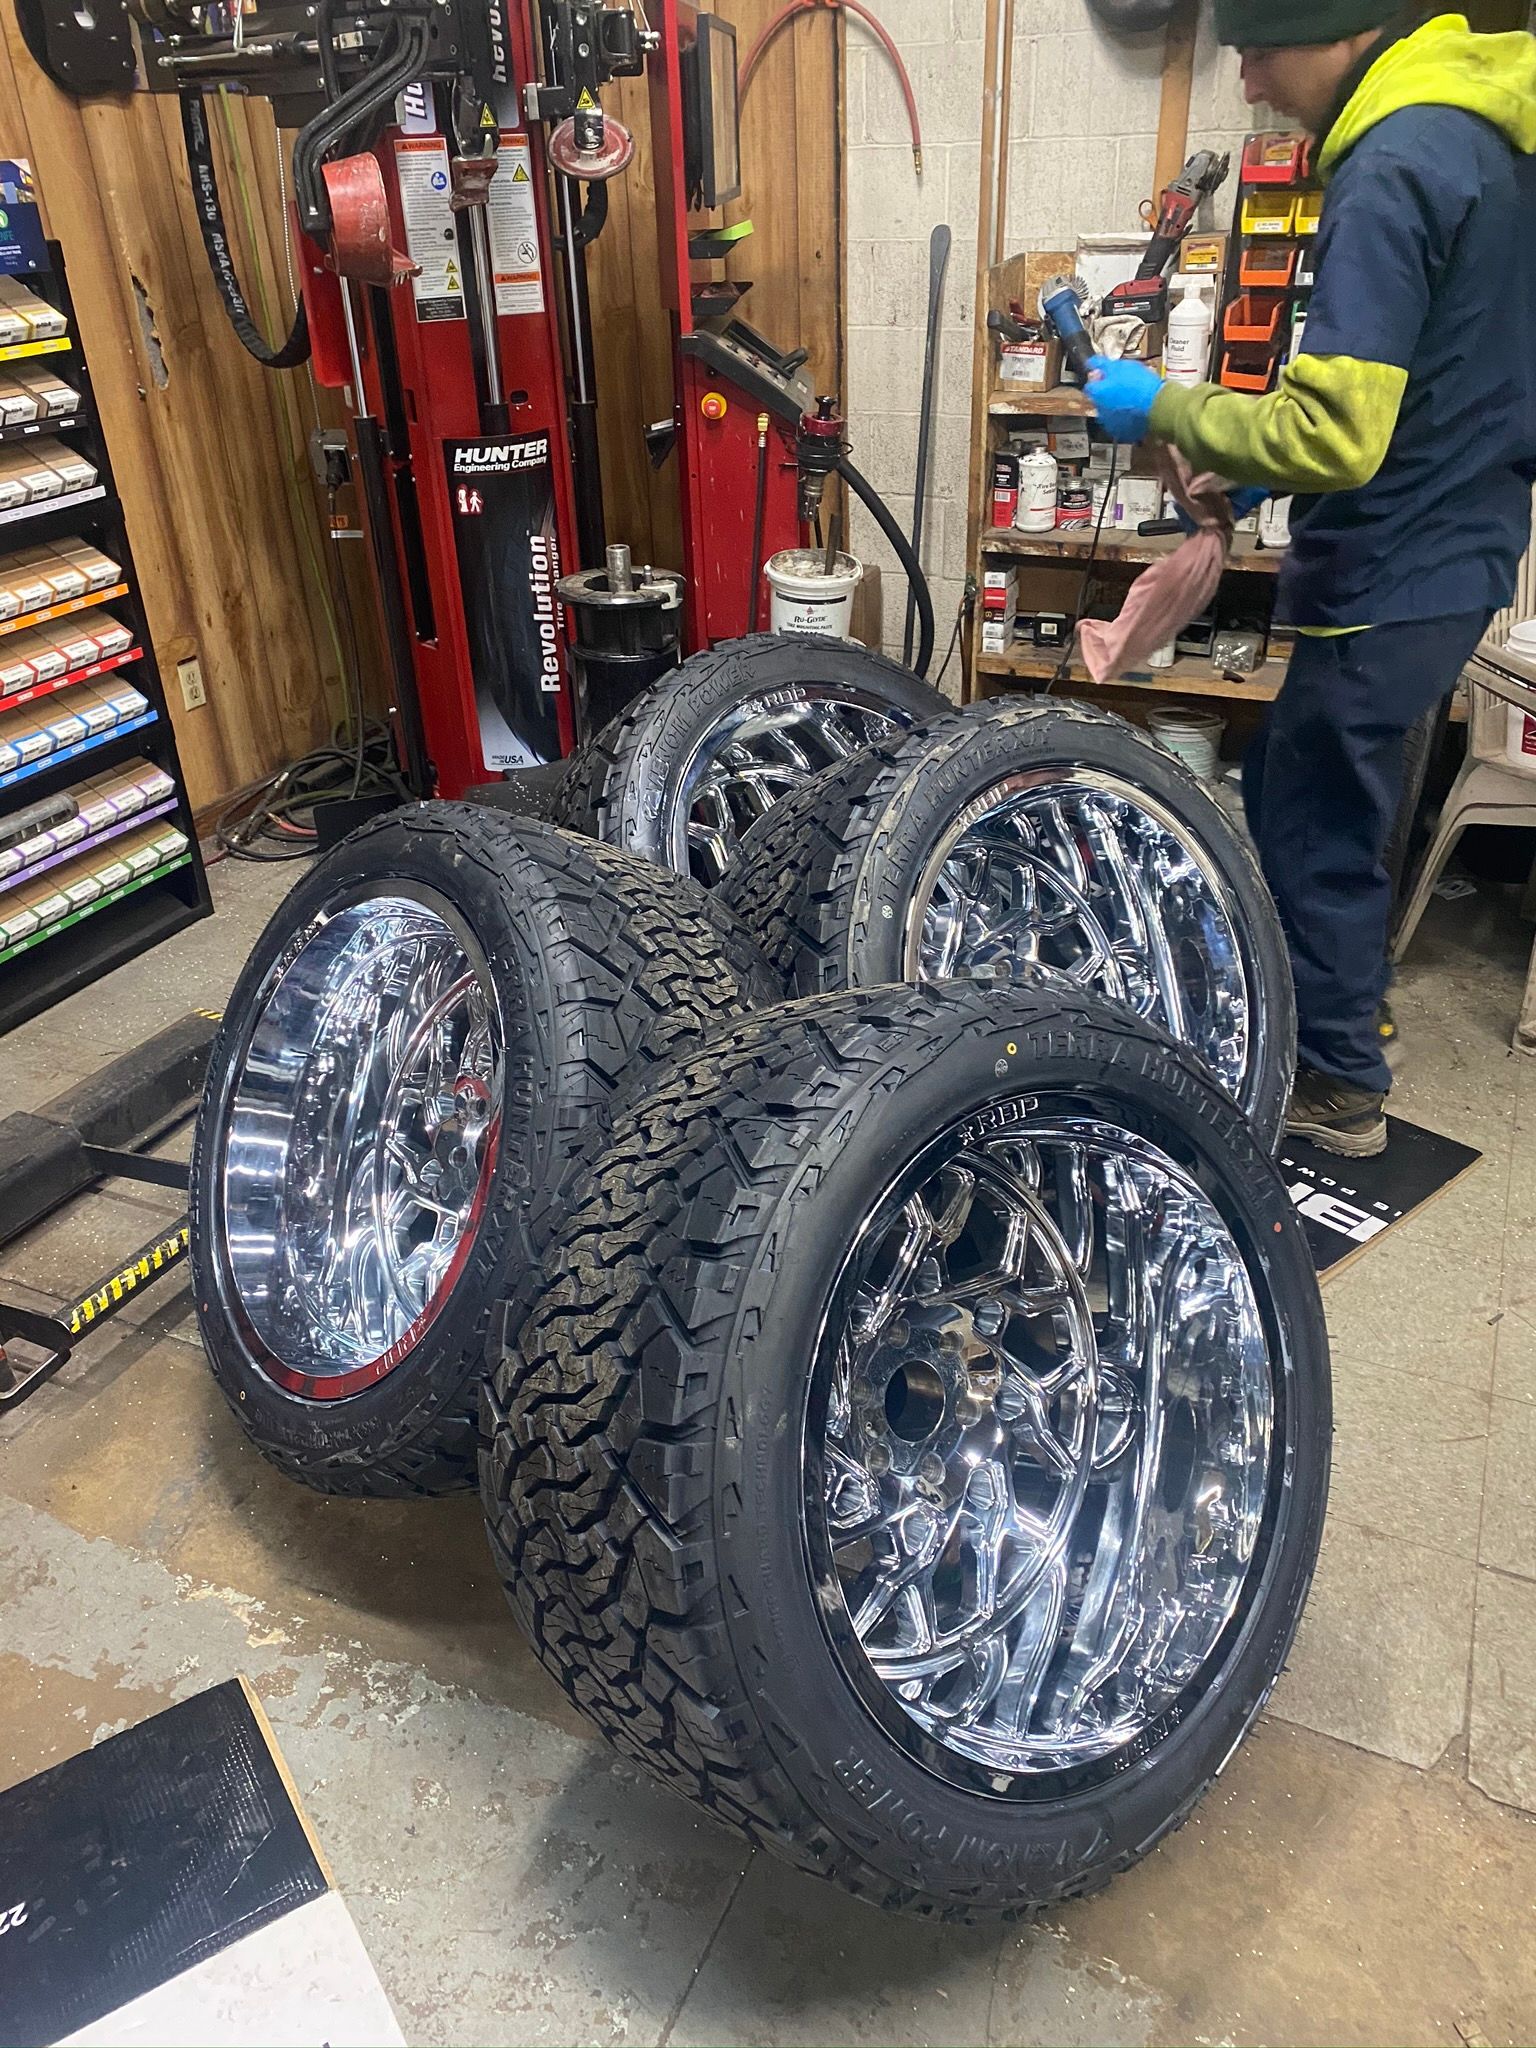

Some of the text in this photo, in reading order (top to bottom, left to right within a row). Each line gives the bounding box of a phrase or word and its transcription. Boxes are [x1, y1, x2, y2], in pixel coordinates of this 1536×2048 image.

[402, 82, 428, 121] Hu
[500, 137, 525, 145] ARNING
[453, 455, 548, 474] Engineering Company
[454, 438, 548, 463] HUNTER
[549, 536, 566, 630] Tire hanger
[528, 534, 561, 692] Revolution
[686, 660, 758, 718] POWER
[504, 755, 524, 764] USA
[922, 733, 1012, 812] HUNTER
[496, 935, 533, 1040] TERRA
[1026, 1030, 1132, 1070] TERRA
[499, 1054, 536, 1212] HUNTER
[977, 1095, 1039, 1137] RBP
[1279, 1157, 1358, 1197] POWE
